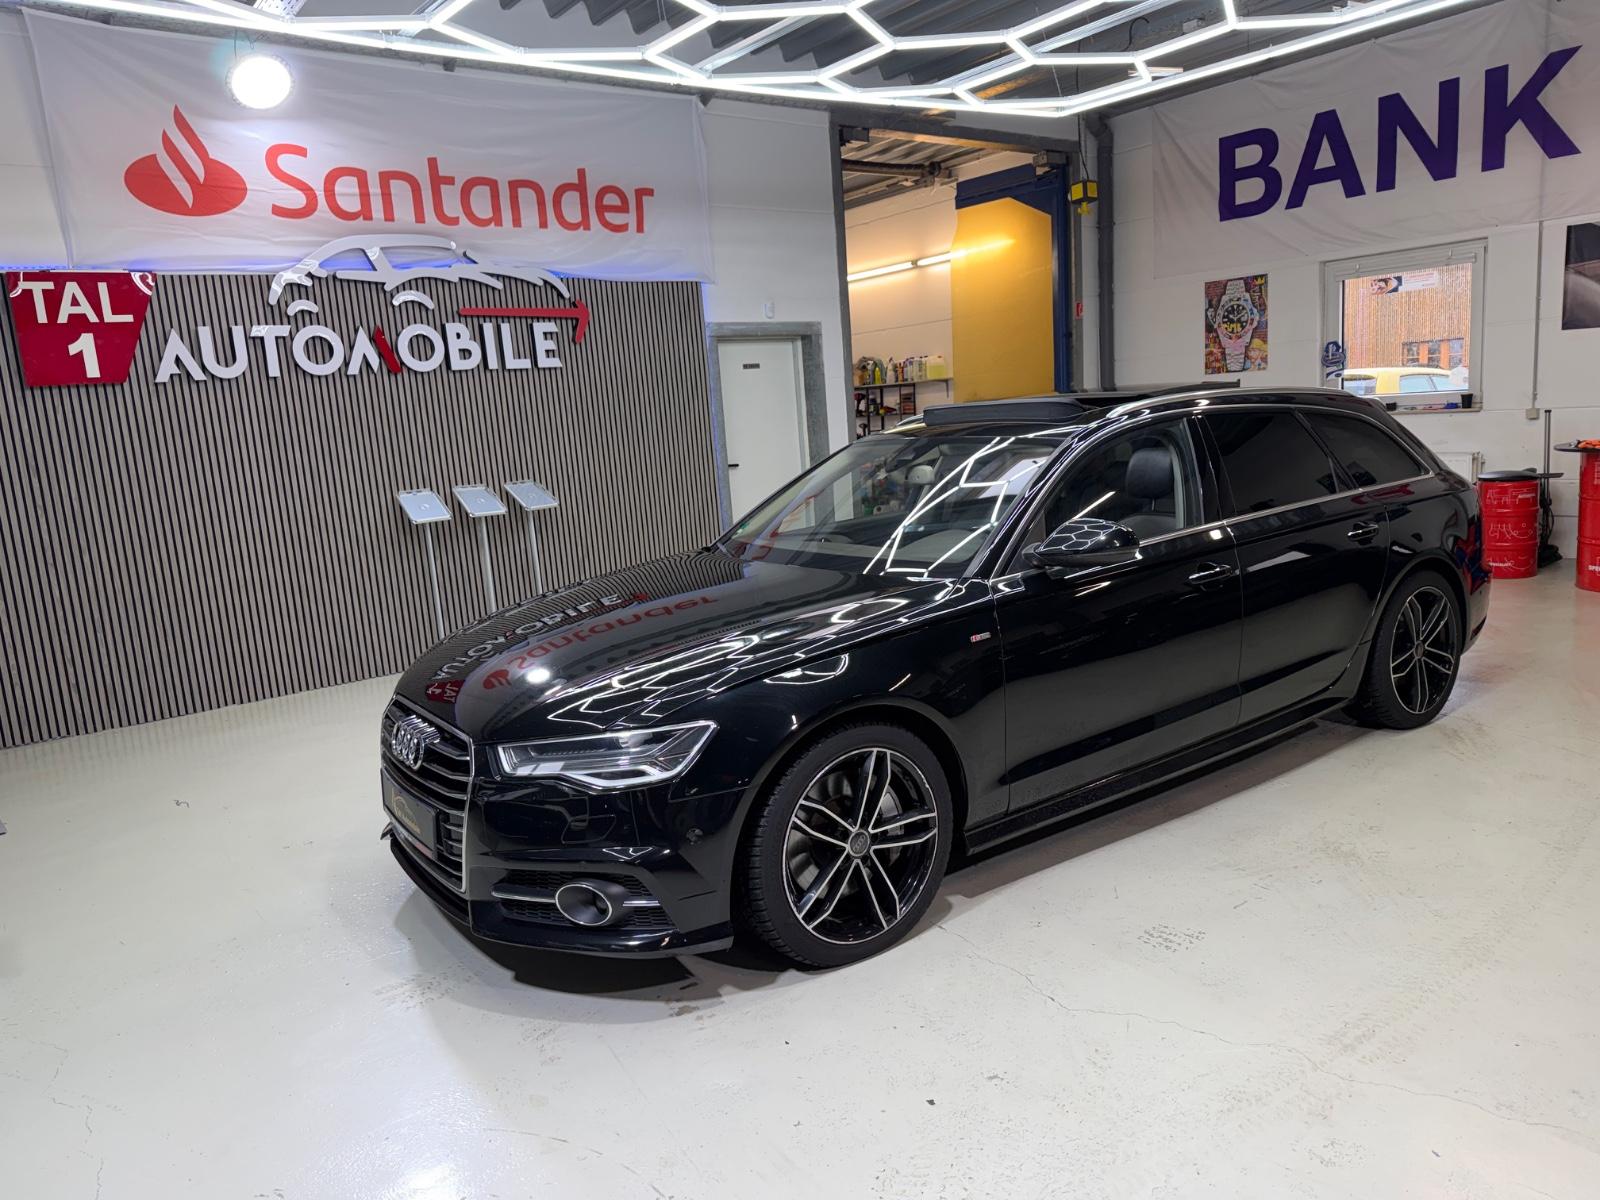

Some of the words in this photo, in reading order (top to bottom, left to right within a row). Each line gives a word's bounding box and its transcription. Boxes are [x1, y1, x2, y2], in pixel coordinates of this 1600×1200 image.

[1218, 45, 1583, 222] BANK
[264, 143, 654, 233] Santander
[18, 281, 134, 324] TAL
[68, 332, 101, 378] 1
[155, 322, 563, 383] AUTOMOBILE
